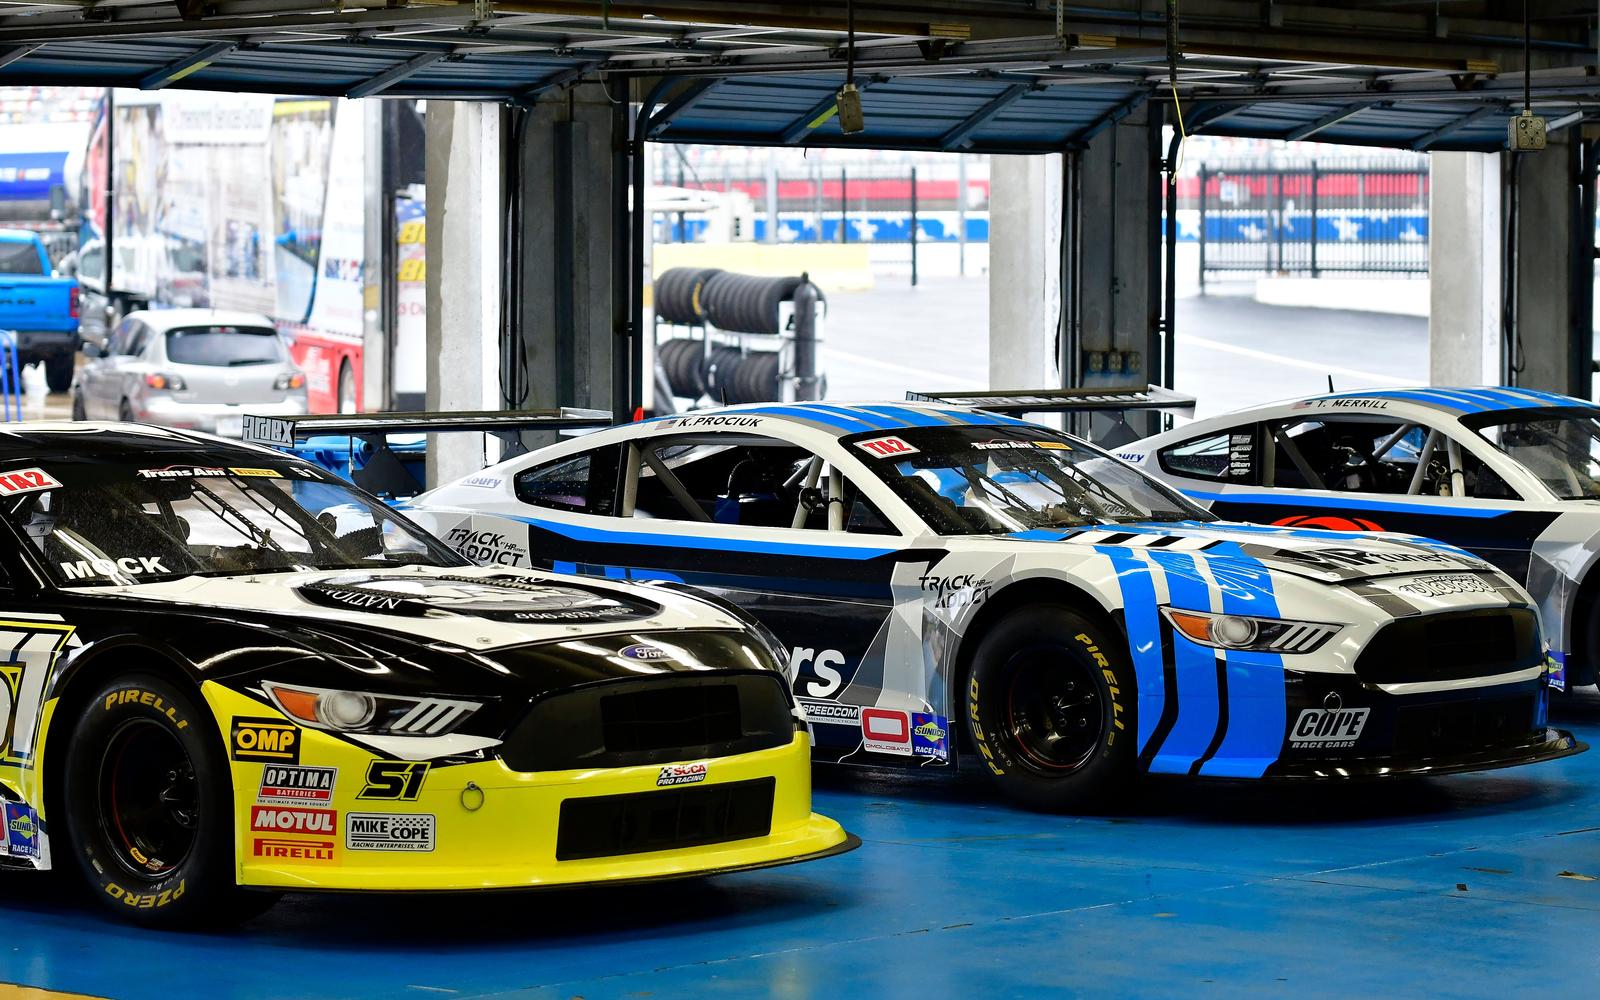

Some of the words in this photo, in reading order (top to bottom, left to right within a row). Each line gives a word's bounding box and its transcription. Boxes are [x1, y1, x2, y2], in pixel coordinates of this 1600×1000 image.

[1317, 400, 1327, 408] T.
[1332, 399, 1388, 409] MERRILL
[242, 415, 294, 444] ardex
[861, 439, 913, 456] TA2
[971, 442, 1009, 450] Trans
[1010, 441, 1032, 449] Am
[137, 469, 192, 479] Trans
[193, 467, 226, 477] Am
[0, 471, 53, 491] TA2
[448, 528, 505, 547] TRACK
[60, 556, 171, 580] MOCK
[918, 574, 975, 599] TRACK
[1075, 633, 1124, 730] PIRELLI
[105, 688, 189, 730] PIRELLI
[802, 704, 858, 718] SPEEDCOM
[1296, 711, 1366, 737] COPE
[236, 728, 295, 751] OMP
[915, 726, 946, 738] SUNOCO
[865, 743, 911, 753] OMOLOGATO
[915, 746, 932, 755] RACE
[1292, 741, 1324, 749] RACE
[1325, 740, 1356, 748] CARS
[673, 764, 706, 776] SCCA
[266, 769, 330, 788] OPTIMA
[357, 760, 431, 801] 51
[657, 777, 674, 786] PRO
[675, 774, 704, 784] RACING
[276, 789, 317, 798] BATTERIES
[254, 809, 334, 832] MOTUL
[351, 820, 388, 833] MIKE
[390, 827, 429, 840] COPE
[12, 844, 28, 854] RACE
[254, 838, 334, 860] PIRELLI
